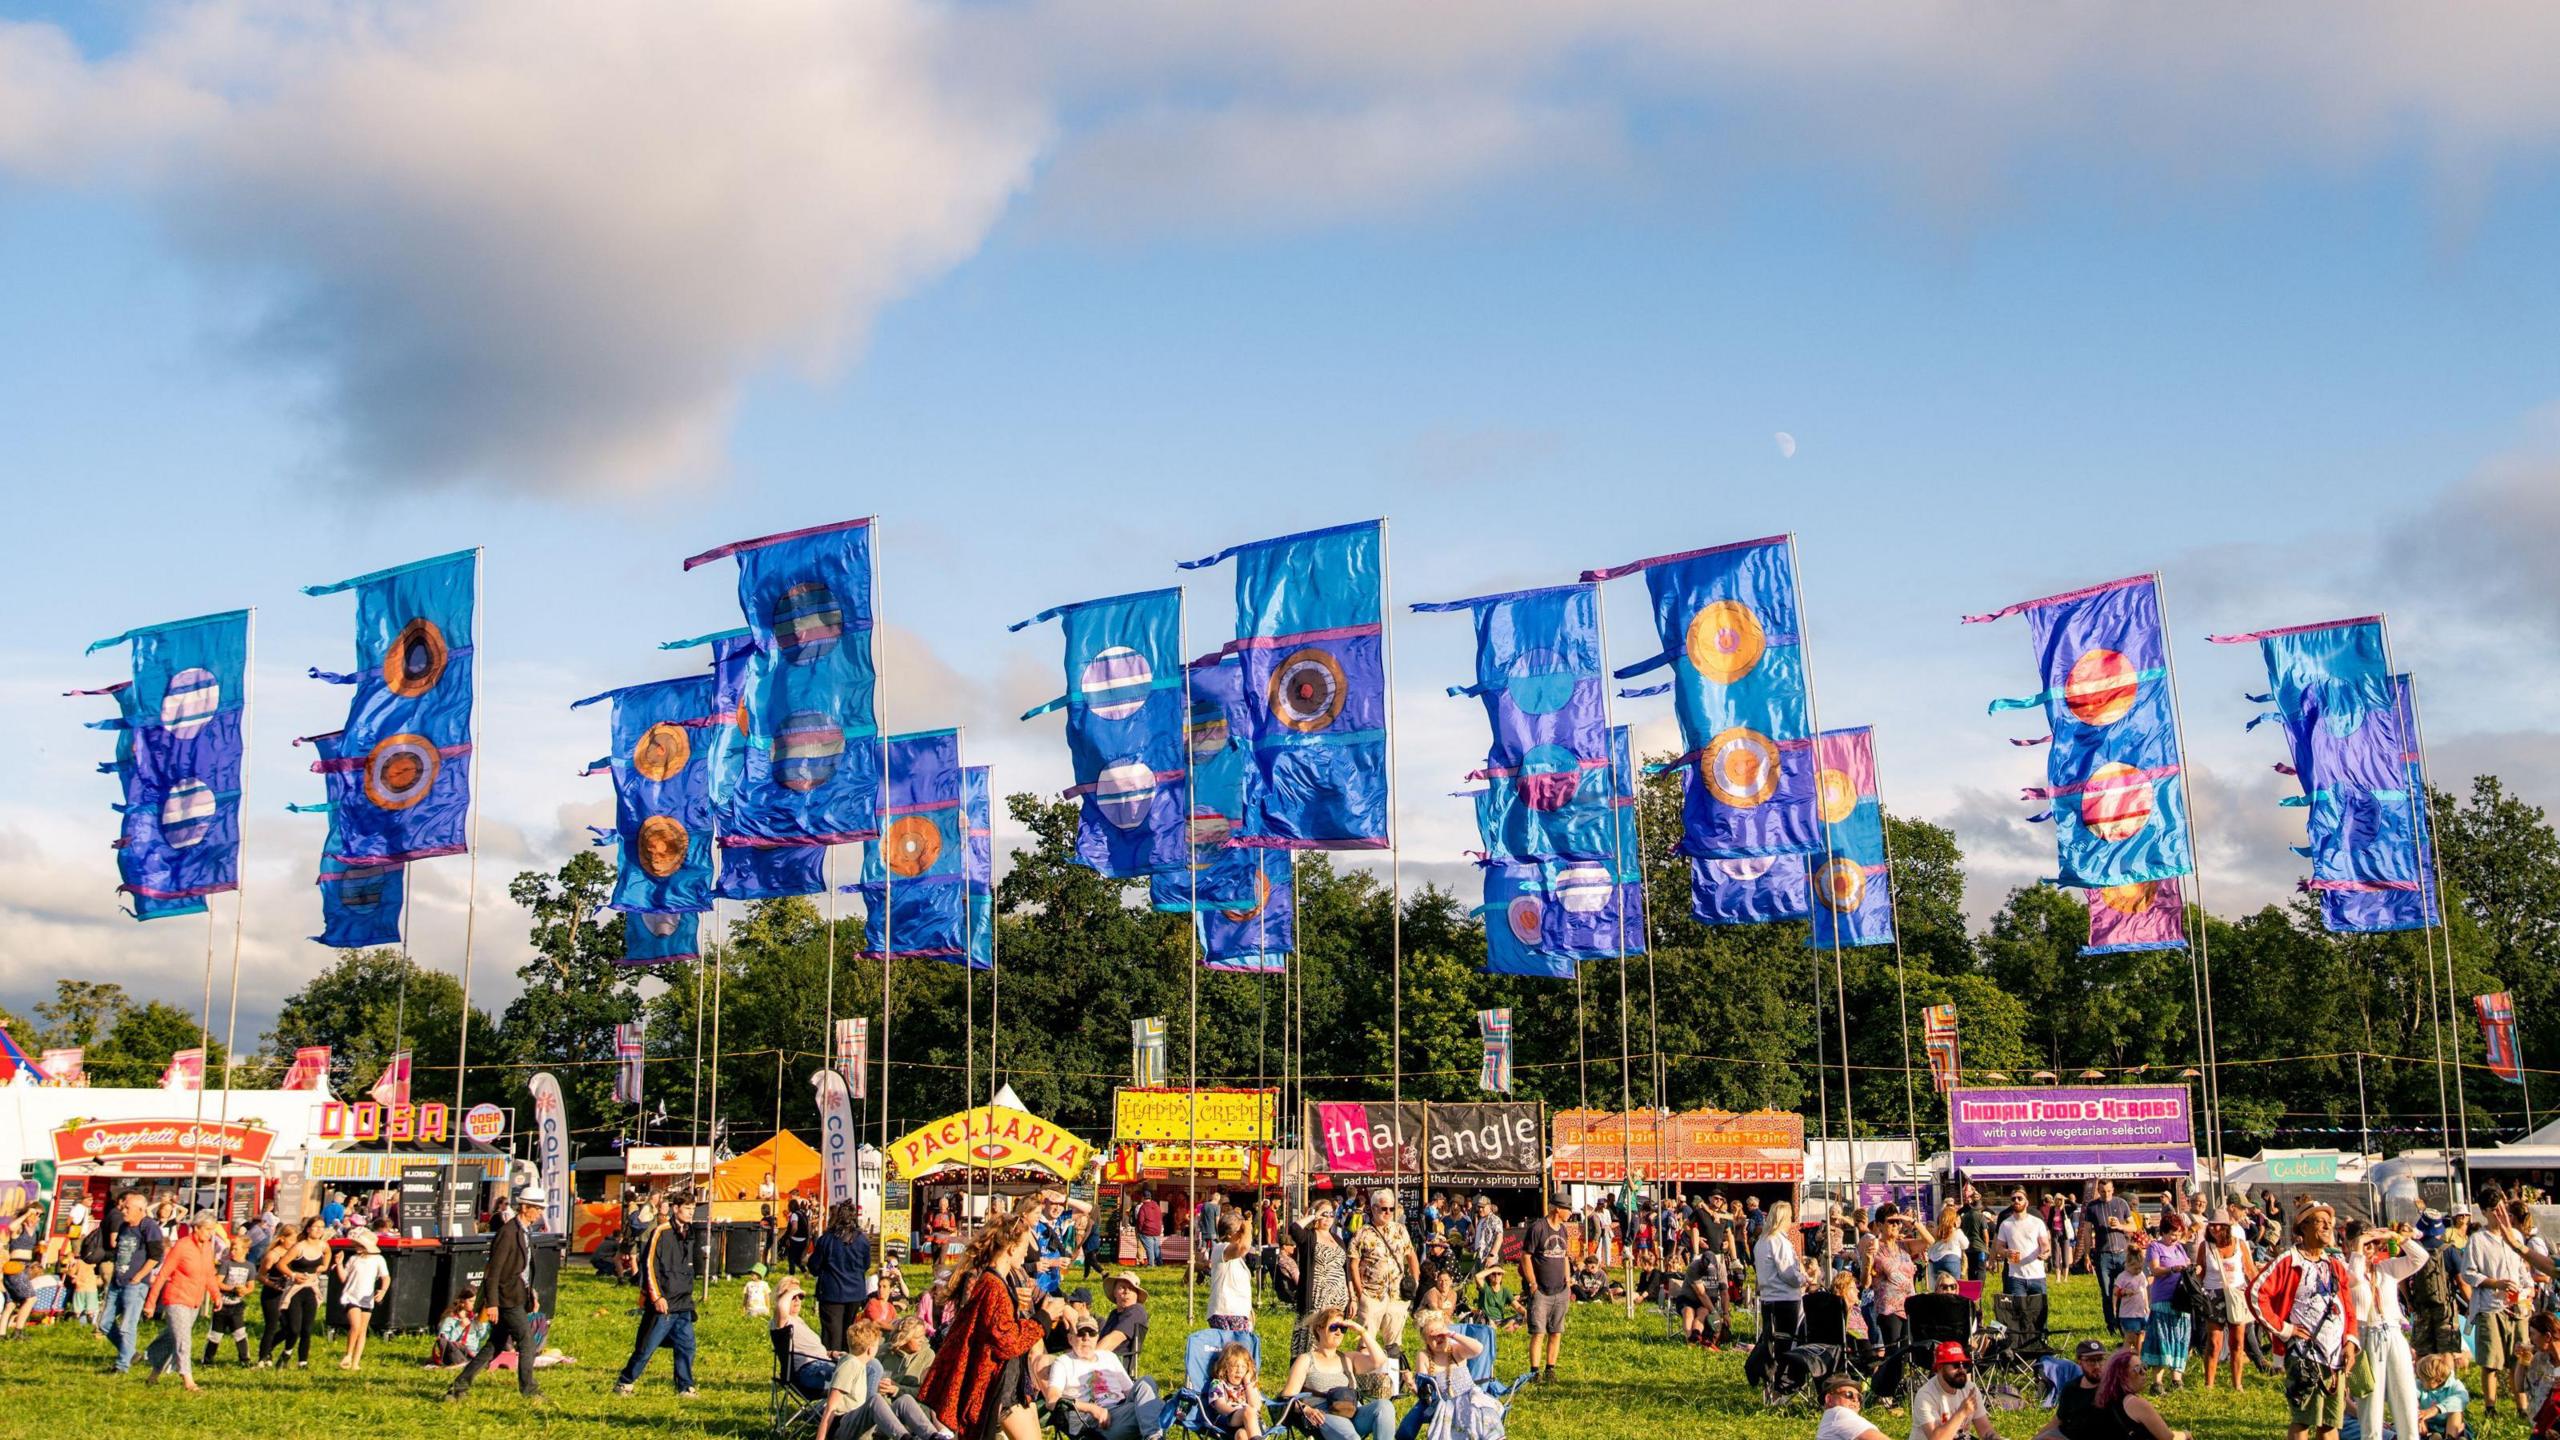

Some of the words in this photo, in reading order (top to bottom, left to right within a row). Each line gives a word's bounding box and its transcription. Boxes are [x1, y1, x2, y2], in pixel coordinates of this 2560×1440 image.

[320, 1101, 448, 1142] DOSA
[469, 1113, 501, 1125] DOSA
[1123, 1103, 1191, 1122] HAPPY
[1961, 1101, 2029, 1123] INDIAN
[2029, 1100, 2082, 1121] FOOD
[2083, 1101, 2099, 1120] &
[2099, 1098, 2180, 1121] KEBABS
[84, 1128, 179, 1153] Spaghetti
[472, 1124, 499, 1136] DELI
[905, 1112, 1080, 1169] PAELLARIA
[1327, 1120, 1404, 1157] thai
[1431, 1113, 1536, 1160] angle
[1983, 1127, 2007, 1138] with
[2020, 1126, 2047, 1137] wide
[2050, 1125, 2109, 1139] vegetarian
[2112, 1124, 2162, 1135] selection
[312, 1156, 370, 1178] SOUTH
[544, 1118, 561, 1220] COFFEE
[632, 1163, 665, 1171] RITUAL
[669, 1162, 708, 1170] COFFEE
[827, 1115, 848, 1204] COFFE
[1343, 1176, 1361, 1186] pad
[1363, 1176, 1383, 1185] thai
[1384, 1175, 1423, 1185] noodles
[1430, 1174, 1450, 1184] thai
[1451, 1174, 1479, 1185] curry
[1486, 1175, 1517, 1186] spring
[1519, 1175, 1541, 1185] rolls
